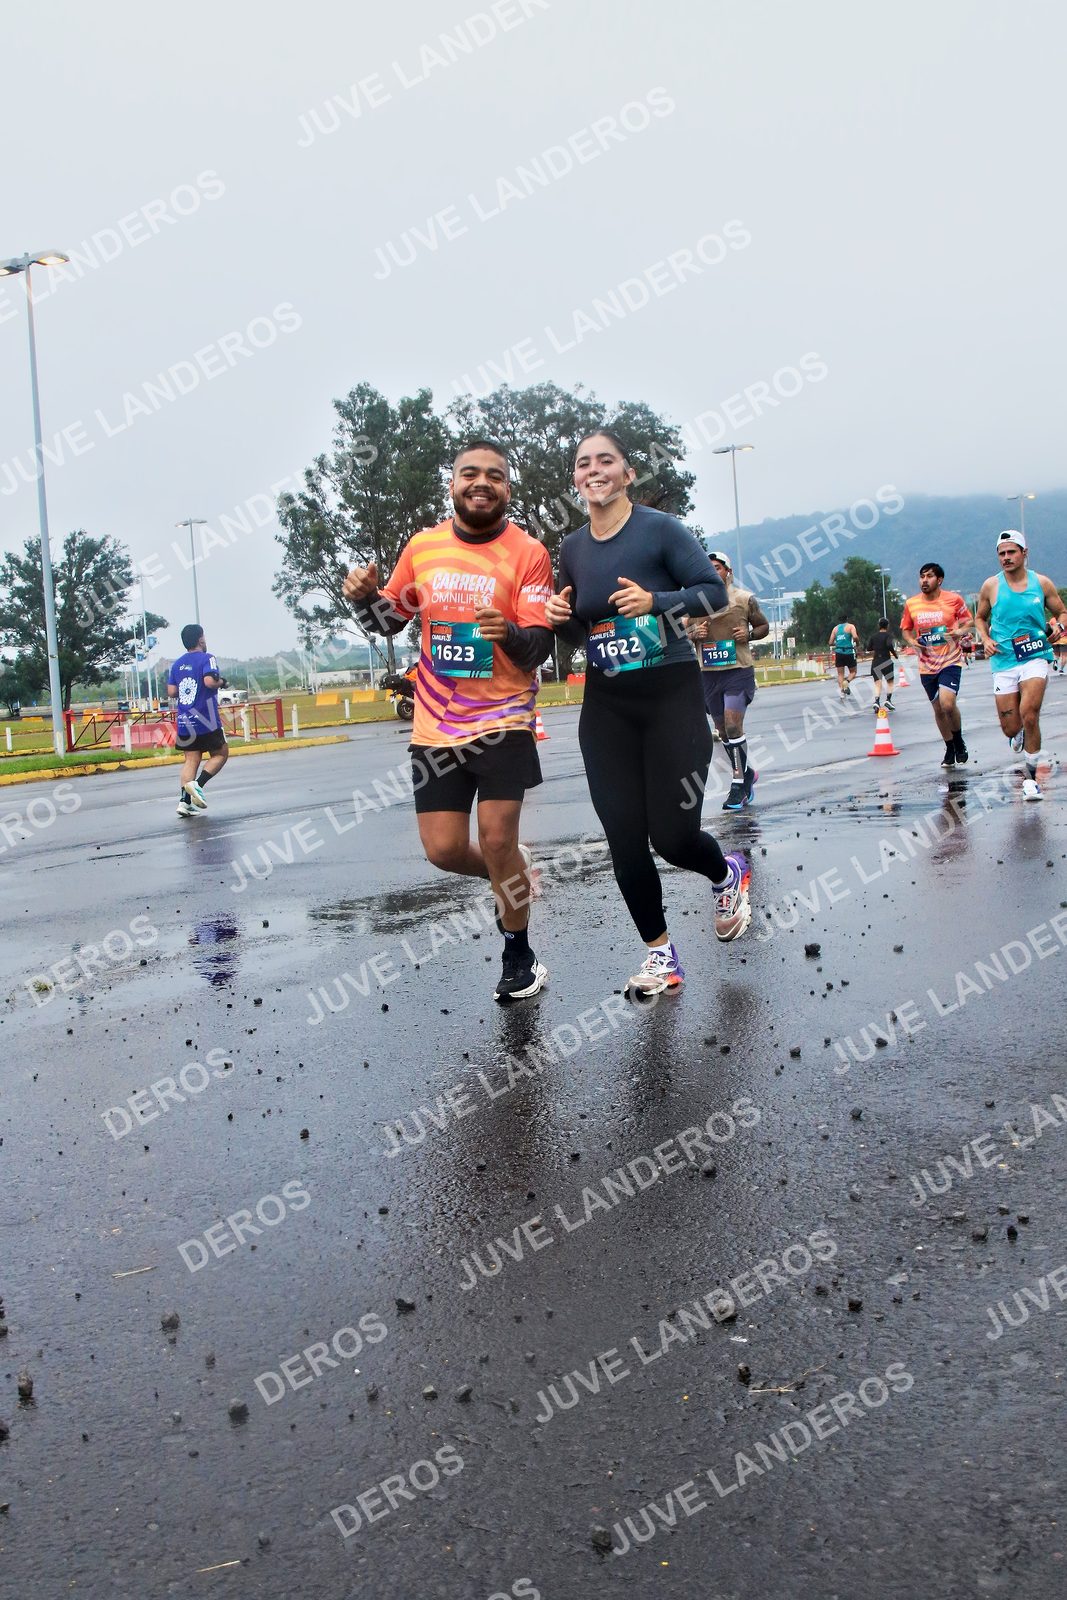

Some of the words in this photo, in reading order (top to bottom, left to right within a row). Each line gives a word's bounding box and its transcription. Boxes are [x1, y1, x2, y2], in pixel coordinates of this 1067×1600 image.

[432, 572, 496, 593] CARRERA
[431, 592, 479, 605] OMNILIFE
[635, 616, 649, 627] 10K
[472, 627, 483, 638] 10
[924, 634, 941, 642] 1566
[597, 637, 641, 658] 1622
[1020, 639, 1044, 653] 1580
[436, 644, 475, 662] 1623
[707, 650, 729, 659] 1519
